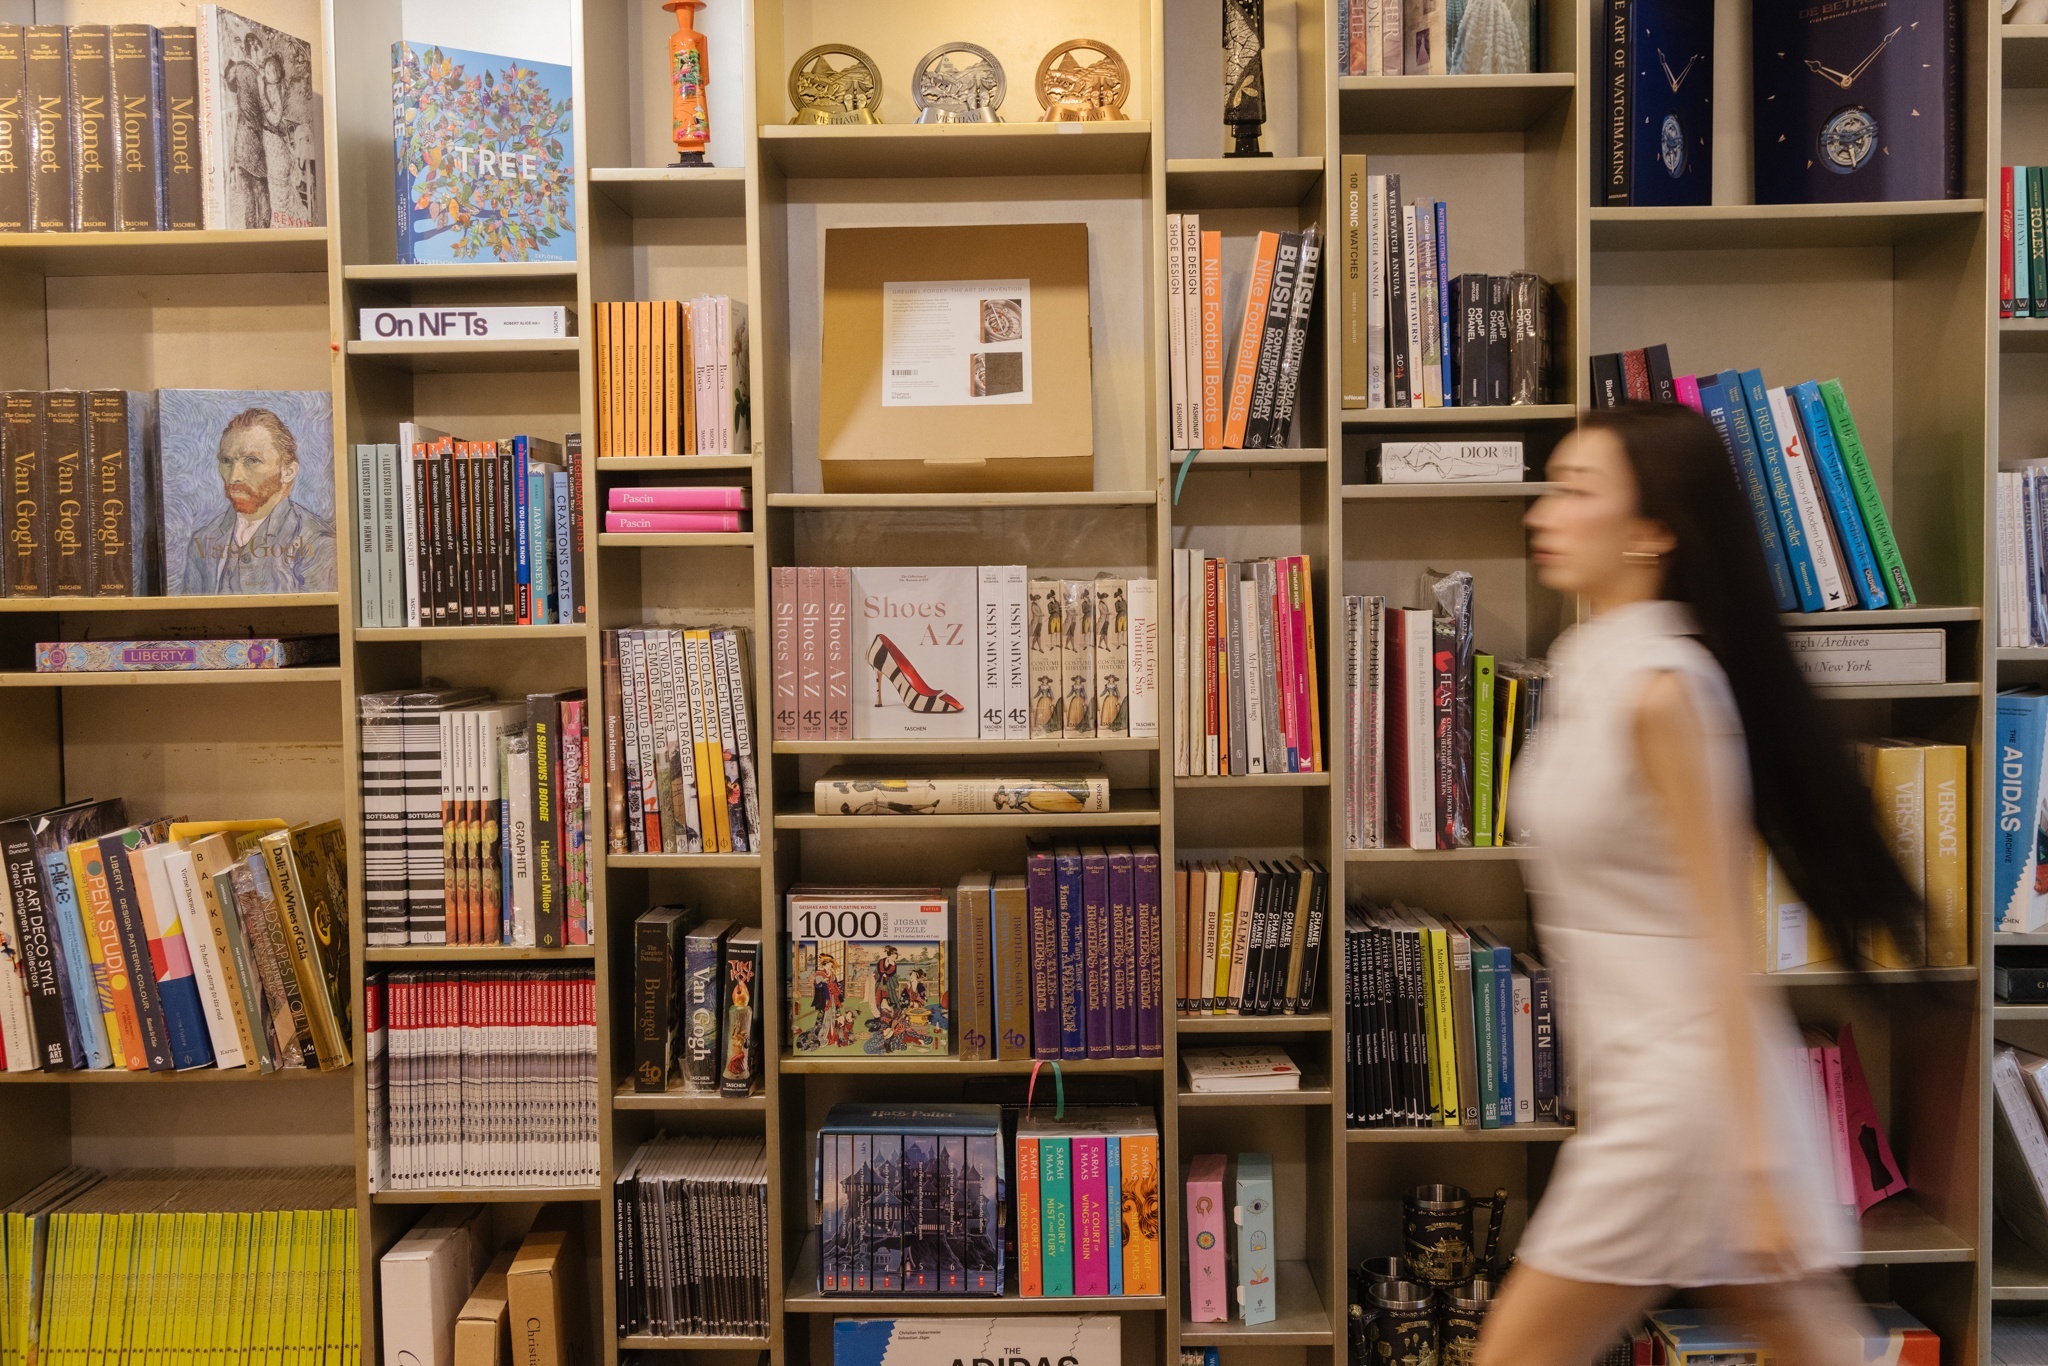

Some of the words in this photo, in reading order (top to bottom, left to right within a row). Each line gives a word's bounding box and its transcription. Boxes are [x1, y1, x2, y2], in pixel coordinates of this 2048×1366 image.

[1614, 15, 1625, 44] ART
[392, 59, 406, 139] TREE
[39, 96, 61, 174] Monet
[124, 94, 146, 174] Monet
[171, 96, 193, 174] Monet
[1613, 74, 1625, 185] WATCHMAKING
[455, 146, 537, 180] TREE
[1350, 173, 1358, 188] 100
[1350, 191, 1358, 228] ICONIC
[1389, 191, 1399, 253] WRISTWATCH
[1187, 224, 1195, 252] SHOE
[2031, 208, 2044, 259] ROLEX
[1350, 231, 1358, 279] WATCHES
[1188, 255, 1196, 295] DESIGN
[1205, 258, 1218, 297] Nike
[1270, 244, 1298, 318] BLUSH
[375, 312, 413, 337] On
[420, 312, 488, 336] NFTs
[1204, 302, 1219, 370] Football
[1261, 328, 1276, 373] MAKEUP
[1262, 329, 1283, 421] CONTEMPORARY
[1205, 374, 1219, 423] Boots
[1252, 374, 1268, 419] ARTISTS
[1756, 407, 1774, 442] FRED
[1461, 446, 1498, 459] DIOR
[1767, 447, 1778, 464] the
[58, 451, 79, 495] Van
[101, 450, 121, 494] Van
[362, 458, 371, 495] ILLUSTRATED
[1771, 465, 1790, 508] sunlight
[1795, 466, 1806, 496] History
[363, 498, 372, 520] MIRROR
[623, 494, 653, 503] Pascin
[1803, 497, 1812, 507] of
[54, 500, 81, 557] Gogh
[98, 500, 125, 556] Gogh
[364, 525, 372, 553] HAWKING
[620, 518, 651, 527] Pascin
[1780, 509, 1801, 546] jeweller
[1807, 507, 1819, 537] Modern
[194, 538, 244, 558] Van
[251, 536, 314, 560] Gogh
[534, 541, 543, 591] JOURNEYS
[1816, 539, 1827, 568] Design
[560, 569, 570, 600] CATS
[864, 596, 946, 618] Shoes
[986, 603, 997, 637] ISSEY
[830, 602, 846, 661] Shoes
[1132, 618, 1145, 673] Paintings
[1146, 622, 1156, 654] What
[620, 641, 632, 687] RASHID
[634, 644, 643, 669] LILI
[648, 644, 660, 684] SIMON
[658, 641, 669, 679] LYNDA
[714, 642, 729, 706] WANGECHI
[727, 640, 739, 675] ADAM
[987, 642, 997, 688] MIYAKE
[1147, 658, 1156, 691] Great
[1847, 661, 1873, 674] York
[663, 683, 675, 732] BENGLIS
[686, 642, 700, 695] NICOLAS
[693, 699, 704, 740] PARTY
[1440, 673, 1452, 712] FEAST
[537, 723, 545, 733] IN
[624, 690, 635, 747] JOHNSON
[636, 672, 652, 777] REYNAUD-DEWAR
[651, 689, 665, 749] STARLING
[672, 641, 686, 708] ELMGREEN
[680, 721, 693, 779] DRAGSET
[719, 710, 732, 739] MUTU
[732, 679, 748, 750] PENDLETON
[829, 710, 848, 726] 45
[537, 735, 547, 780] SHADOWS
[539, 787, 549, 822] BOOGIE
[2000, 746, 2023, 832] ADIDAS
[1938, 780, 1956, 857] VERSACE
[515, 821, 527, 879] GRAPHITE
[541, 841, 550, 882] Harland
[20, 860, 36, 884] THE
[182, 868, 191, 888] Verne
[279, 872, 290, 890] The
[25, 888, 41, 913] ART
[186, 889, 196, 915] Dawson
[284, 891, 298, 925] Wines
[543, 885, 551, 913] Miller
[11, 863, 21, 888] Great
[16, 890, 29, 933] Designers
[25, 943, 38, 988] Collectors
[31, 914, 48, 957] DECO
[293, 926, 300, 937] of
[799, 911, 881, 938] 1000
[1207, 912, 1215, 960] BURBERRY
[1220, 912, 1234, 960] VERSACE
[1235, 911, 1248, 964] BALMAIN
[1254, 913, 1265, 949] CHANEL
[294, 939, 306, 960] Gala
[728, 960, 753, 973] TIKI
[39, 959, 56, 996] STYLE
[694, 967, 710, 1004] Van
[730, 969, 755, 982] POP
[640, 978, 660, 1041] Bruegel
[1439, 984, 1447, 1013] Fashion
[688, 1008, 711, 1061] Gogh
[1538, 1013, 1551, 1048] TEN
[1092, 1213, 1101, 1243] COURT
